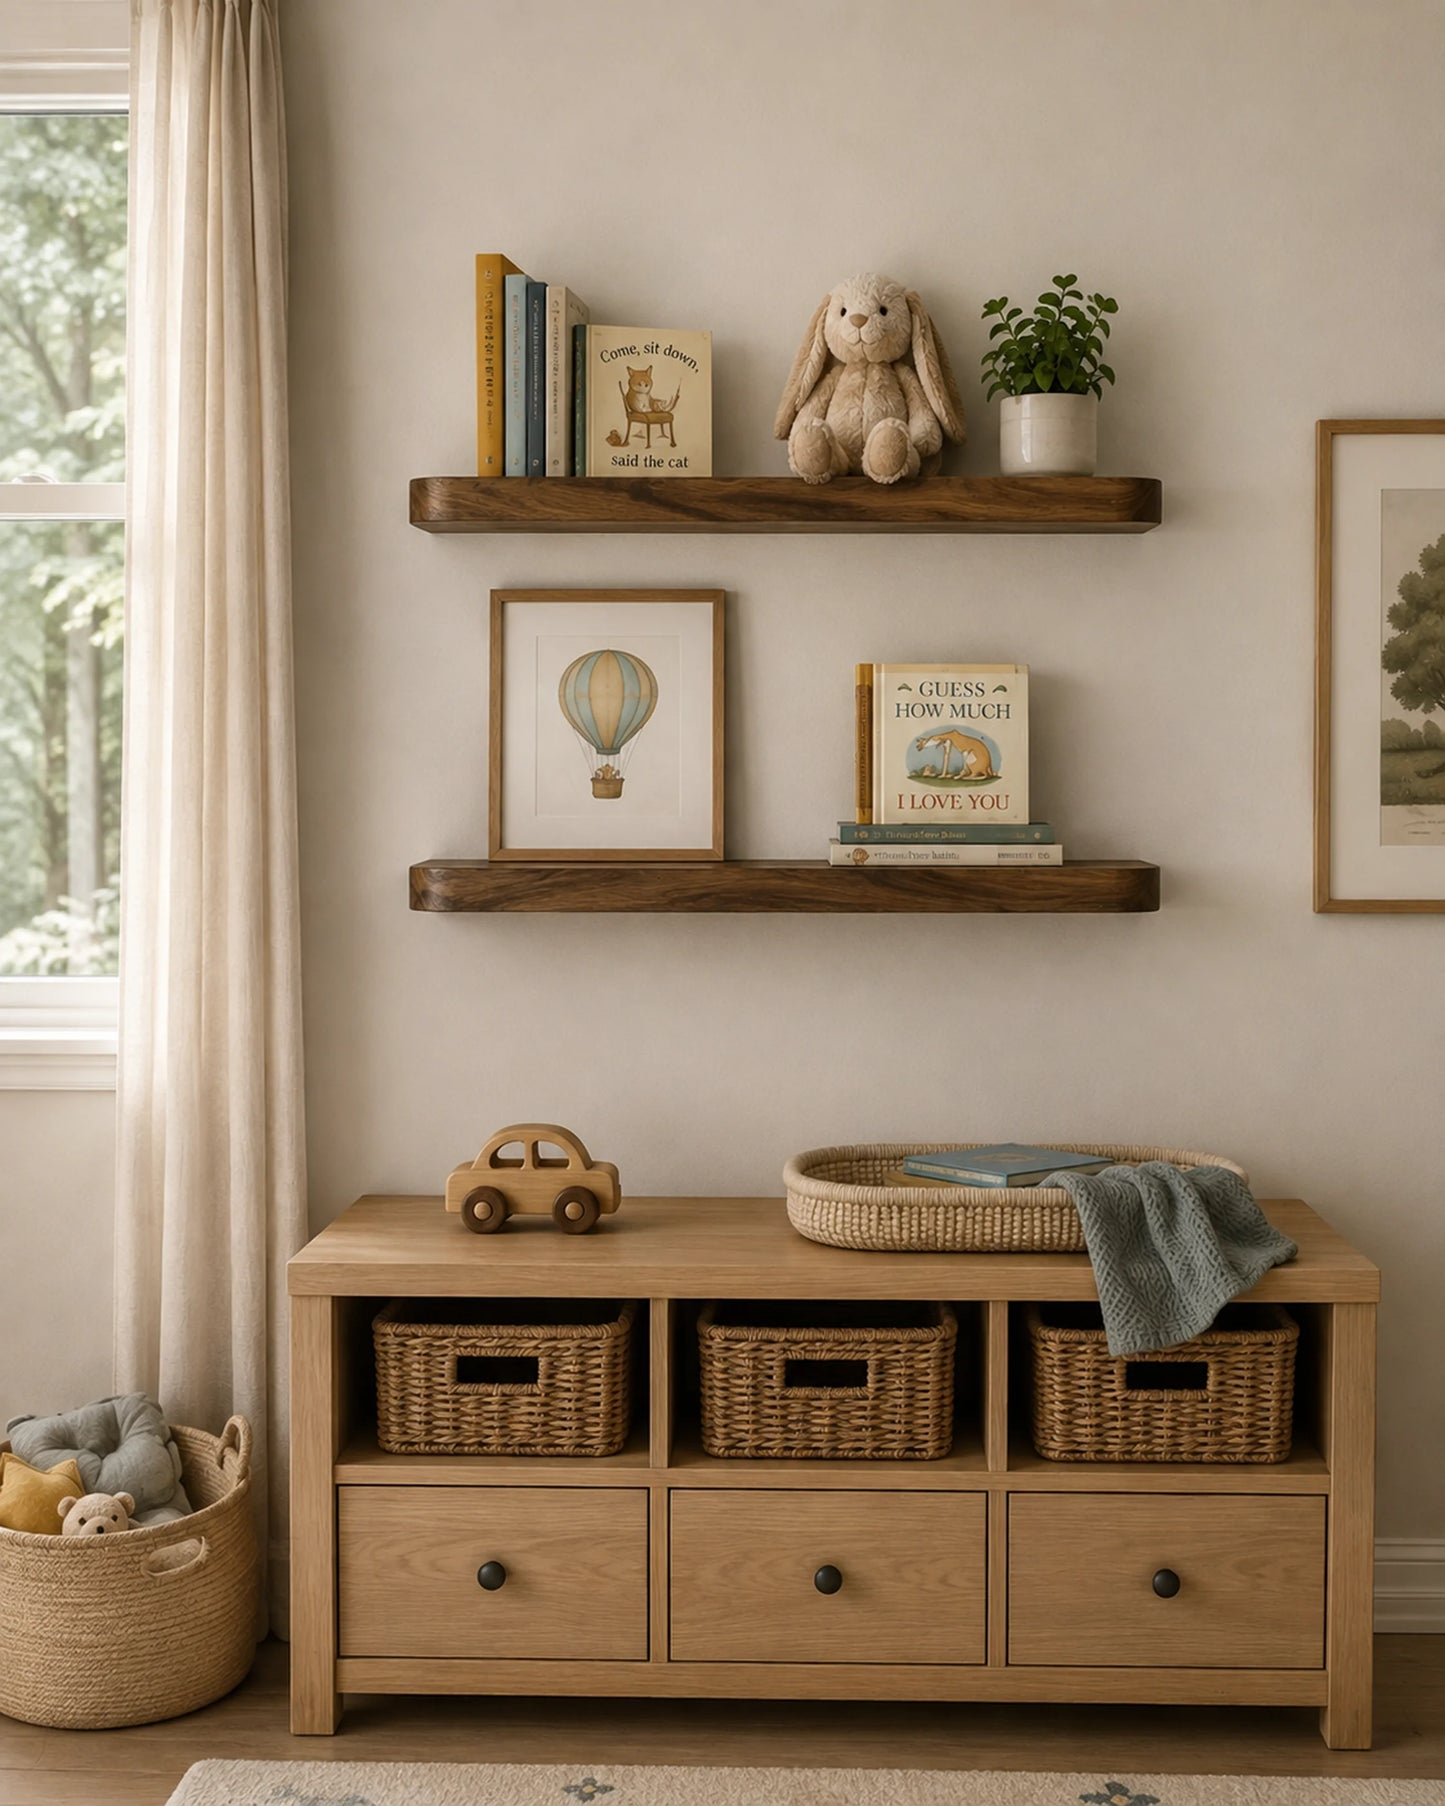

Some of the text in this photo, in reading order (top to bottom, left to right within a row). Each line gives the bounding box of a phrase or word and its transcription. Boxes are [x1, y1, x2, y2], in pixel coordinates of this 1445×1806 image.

[600, 341, 699, 373] Come, sit down,
[611, 454, 688, 469] said the cat
[919, 681, 985, 698] GUESS
[895, 702, 1011, 719] HOW MUCH
[897, 794, 1010, 810] I LOVE YOU
